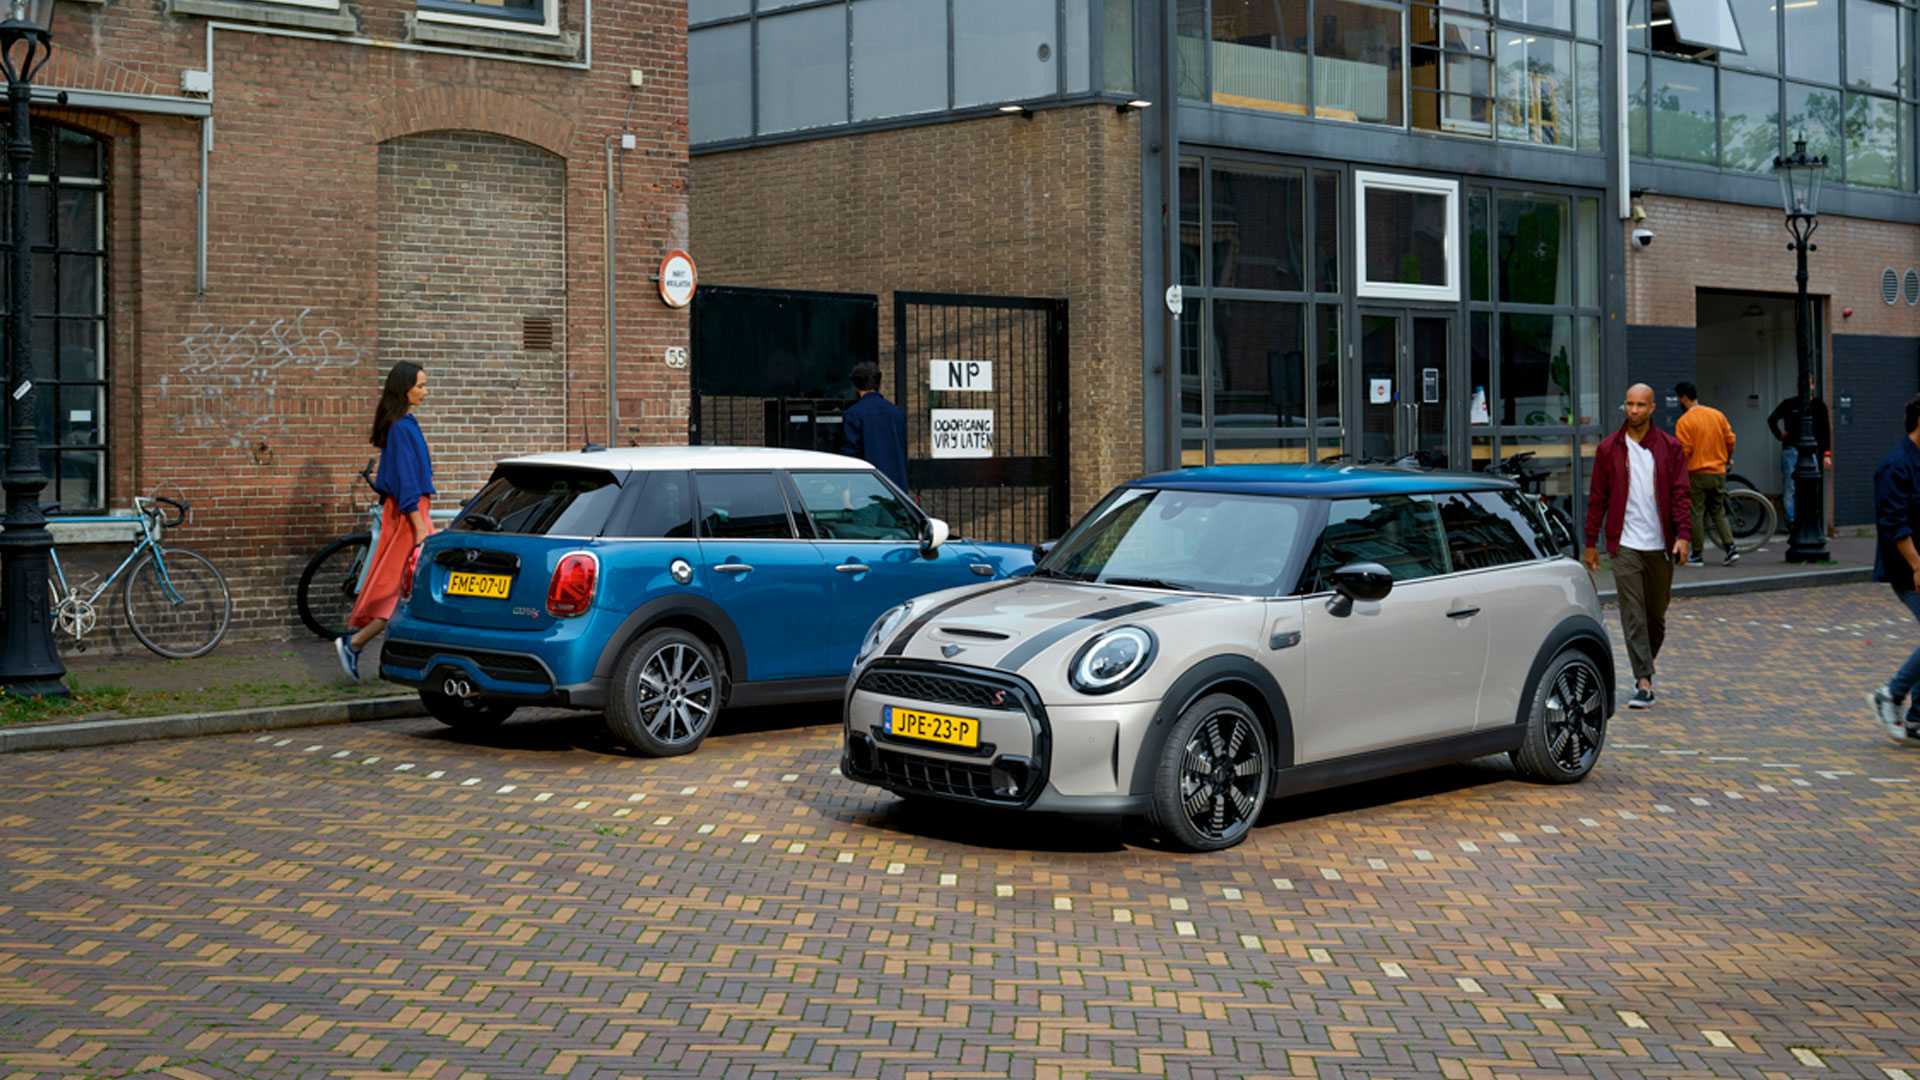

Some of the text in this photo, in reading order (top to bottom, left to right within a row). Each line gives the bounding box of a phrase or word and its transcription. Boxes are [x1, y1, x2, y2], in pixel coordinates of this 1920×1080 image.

[668, 350, 685, 366] 55
[948, 361, 980, 388] NP
[934, 419, 991, 432] DOORGANG
[960, 432, 993, 449] LATEN
[451, 575, 508, 595] FME-07-U
[991, 690, 1006, 705] S
[898, 713, 969, 741] JPE-23-P
